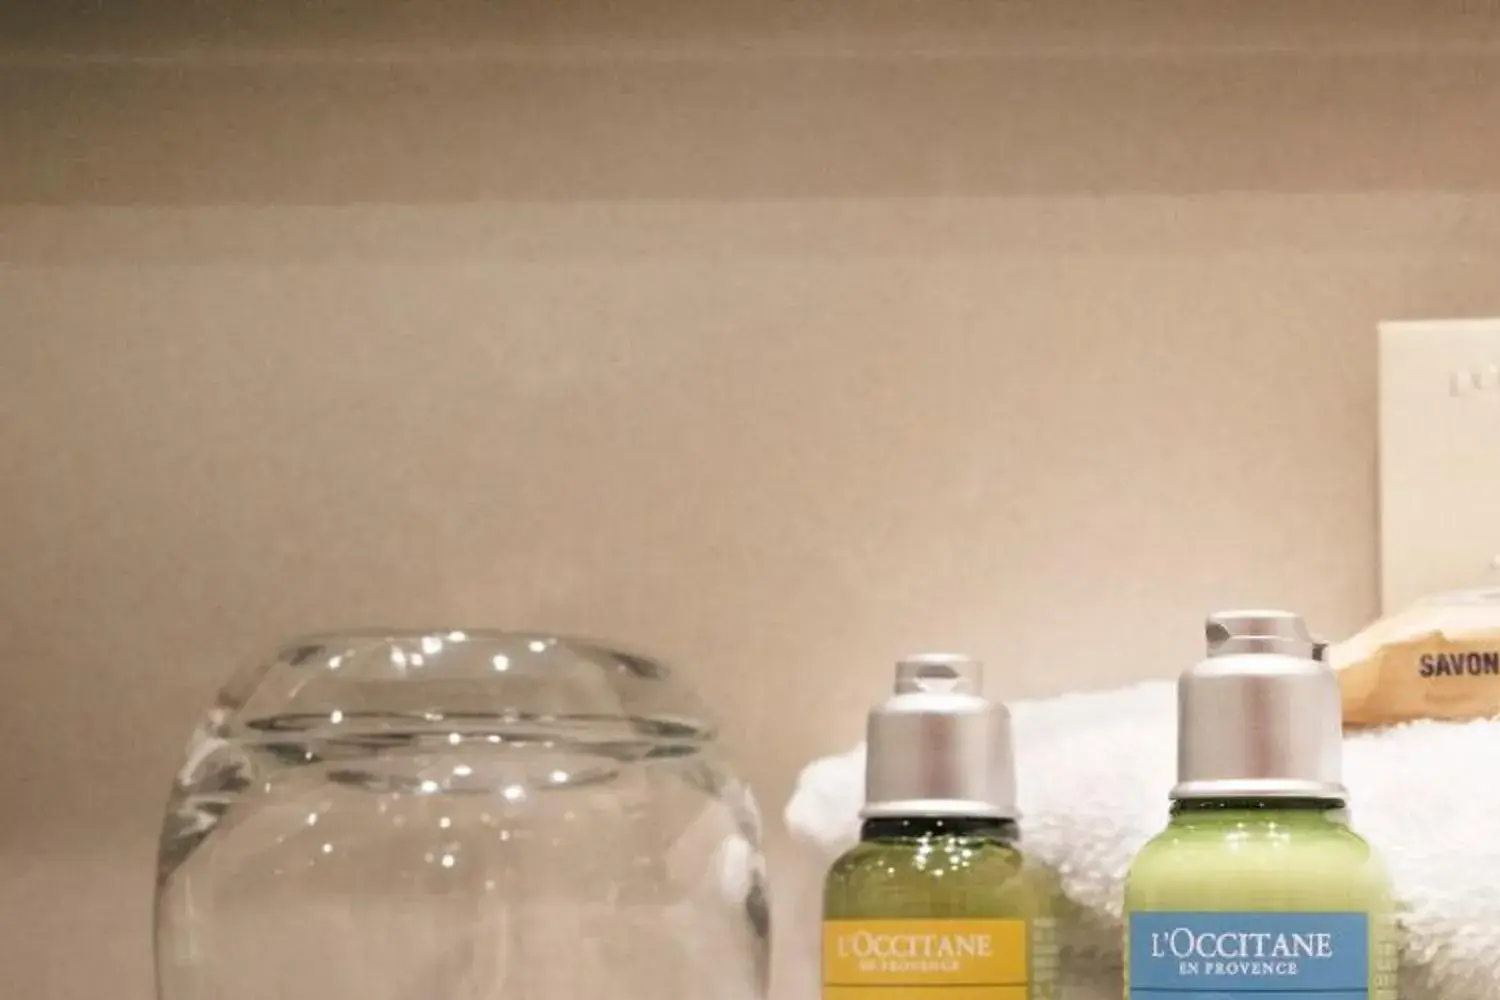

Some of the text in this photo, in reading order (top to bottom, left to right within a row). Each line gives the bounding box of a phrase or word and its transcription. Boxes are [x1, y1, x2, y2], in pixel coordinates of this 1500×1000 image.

[1420, 653, 1500, 677] SAVON
[837, 930, 993, 958] L'OCCITANE
[1152, 928, 1333, 957] L'OCCITANE
[1179, 962, 1298, 975] EN PROVENCE
